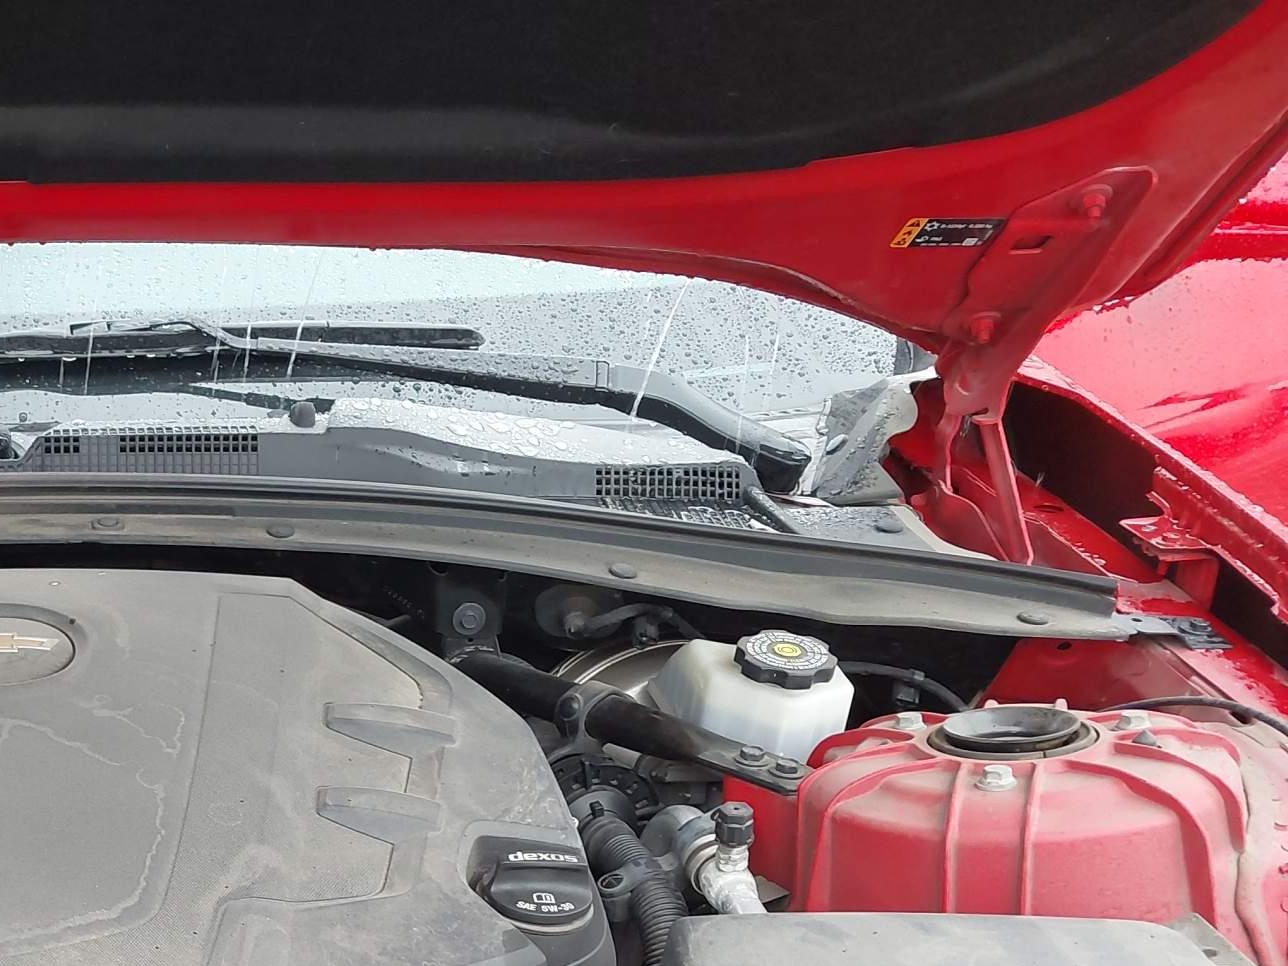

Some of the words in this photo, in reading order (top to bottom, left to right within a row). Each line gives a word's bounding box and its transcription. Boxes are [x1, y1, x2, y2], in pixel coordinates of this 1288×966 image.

[508, 851, 578, 862] dexos
[516, 901, 537, 911] SAE
[541, 902, 575, 912] 5W-30
